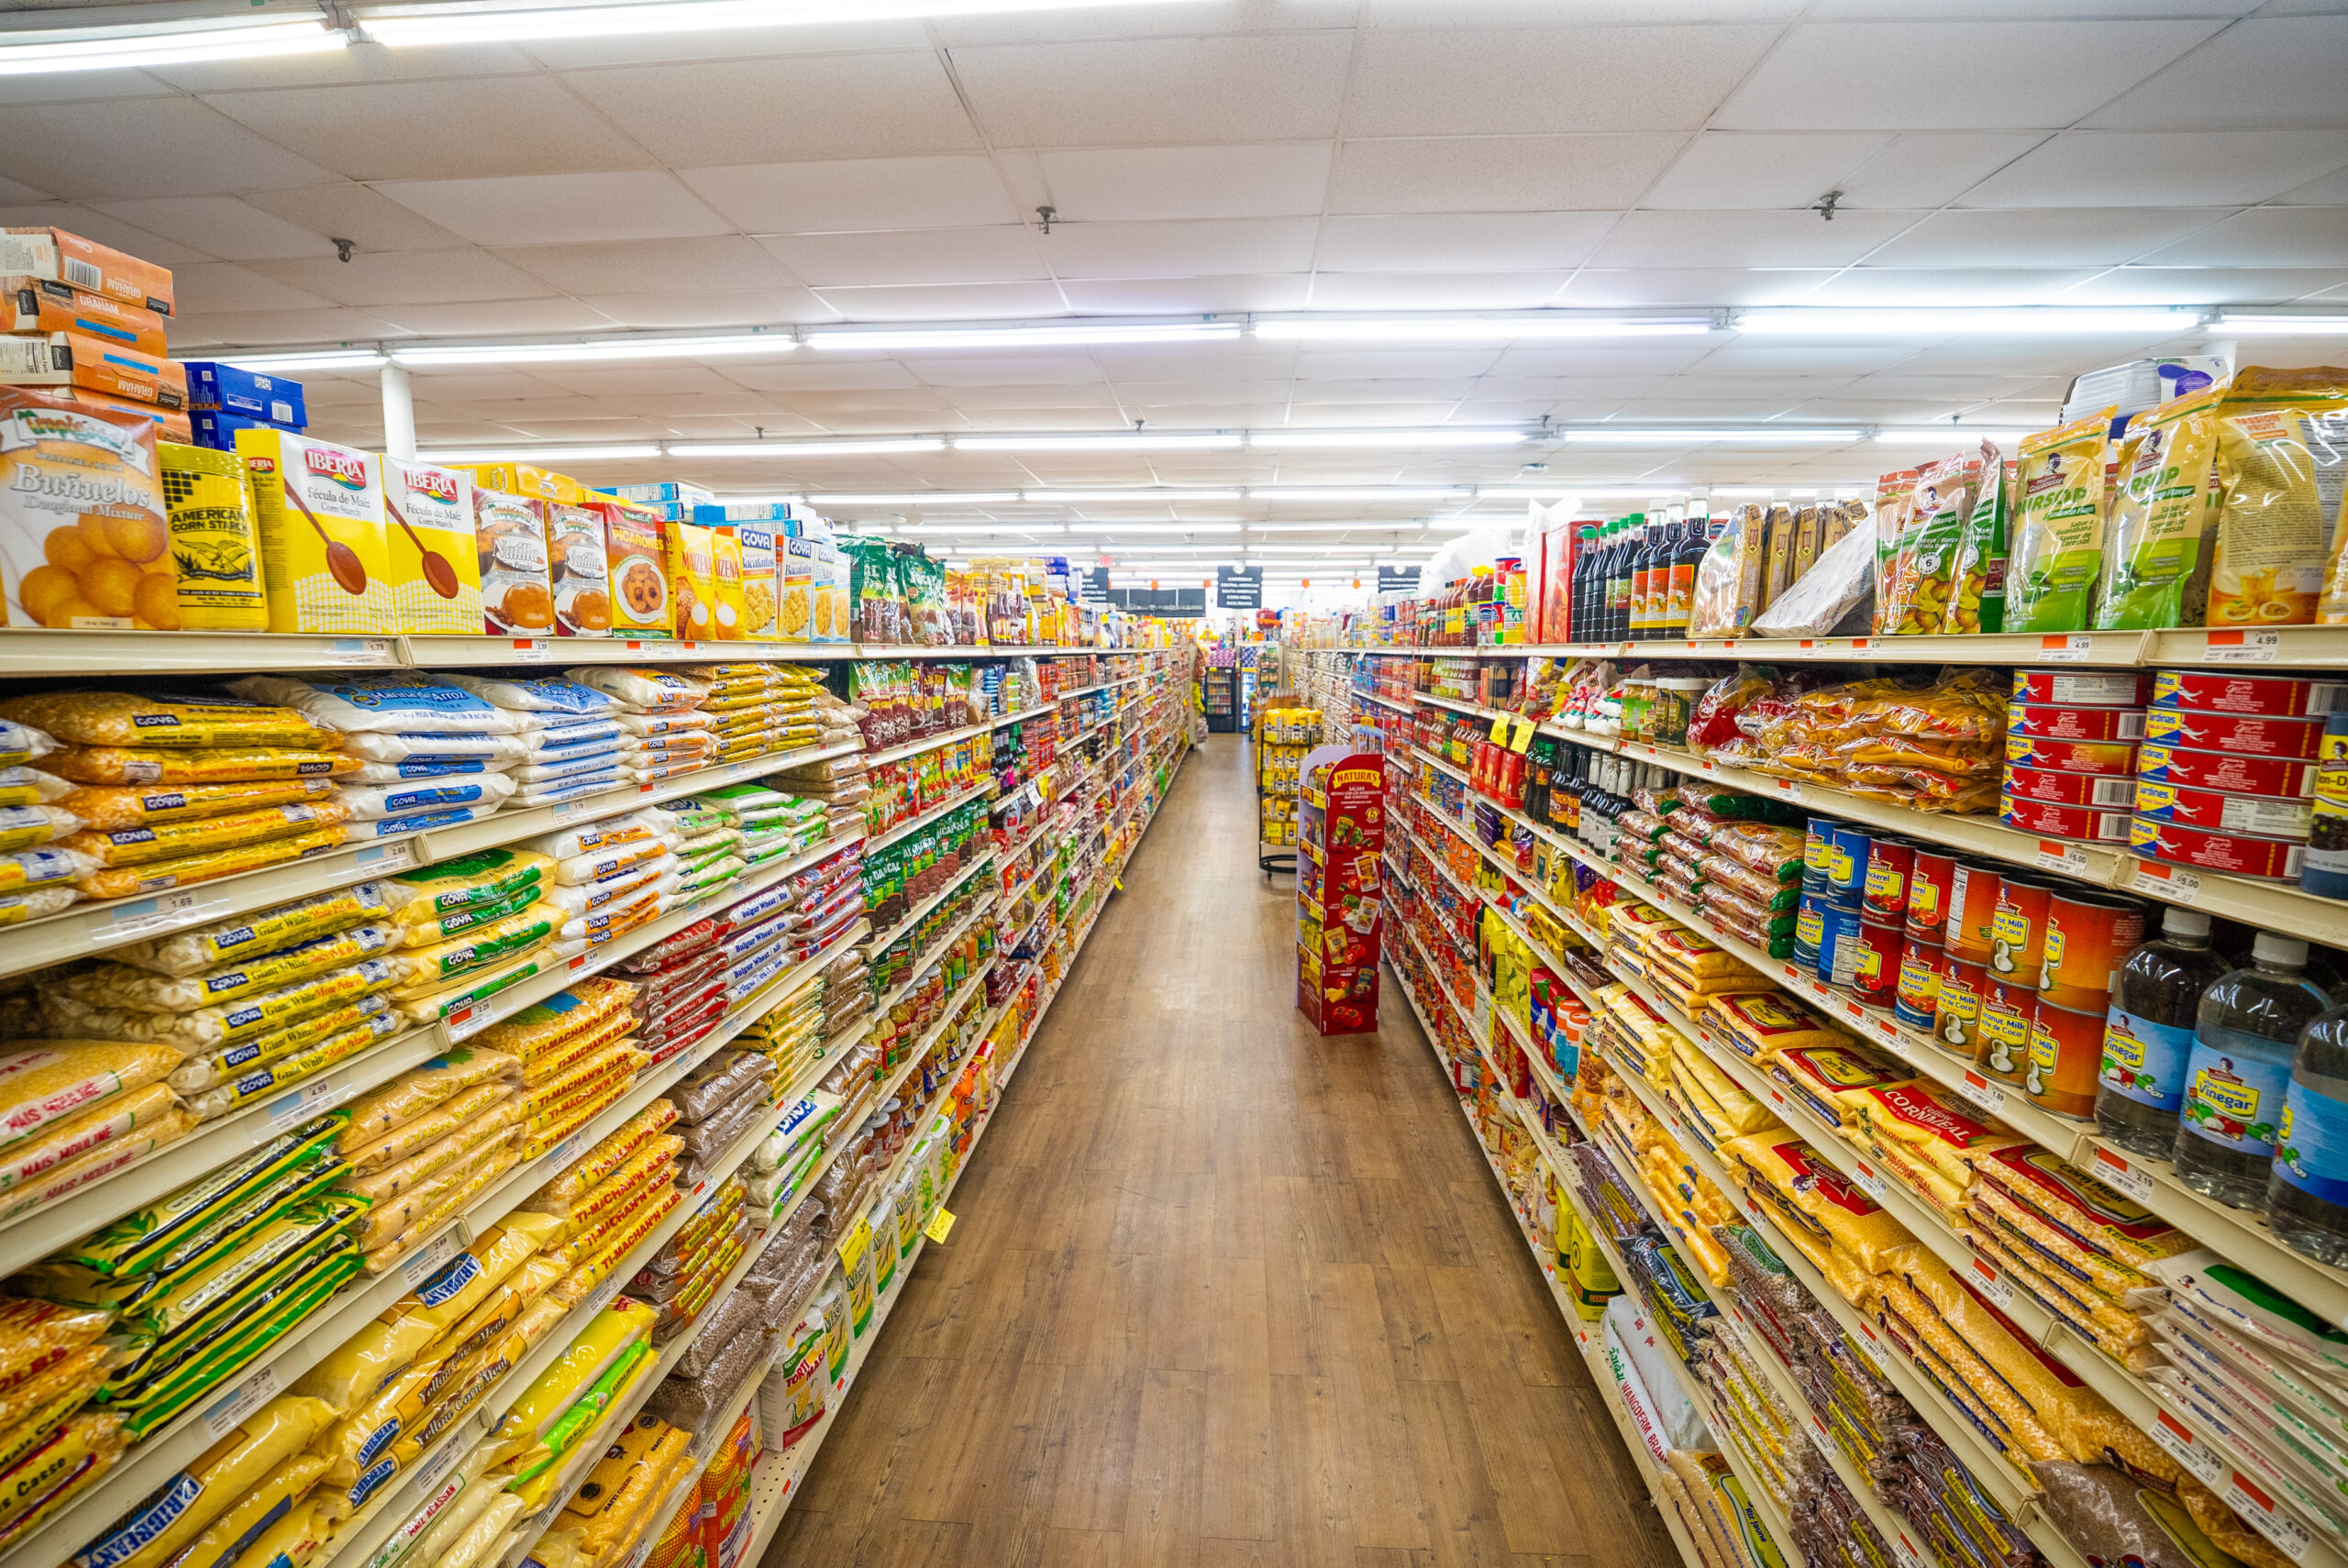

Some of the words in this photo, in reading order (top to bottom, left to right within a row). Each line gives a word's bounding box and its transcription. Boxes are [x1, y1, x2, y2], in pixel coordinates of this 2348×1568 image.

[107, 278, 140, 299] GRAHAM
[79, 295, 119, 315] GRAHAM
[118, 380, 153, 397] GRAHAM
[307, 451, 363, 479] IBERIA
[11, 462, 150, 508] Buñuelos
[406, 473, 456, 497] IBERIA
[307, 487, 338, 502] Fécula
[95, 505, 145, 521] Mixture
[171, 509, 246, 525] AMERICAN
[321, 502, 338, 512] Corn
[339, 506, 360, 517] Starch
[406, 503, 432, 517] Fécula
[434, 509, 443, 517] de
[172, 521, 205, 532] CORN
[209, 520, 248, 532] STARCH
[418, 516, 433, 525] Corn
[435, 520, 454, 529] Starch
[613, 529, 663, 550] PICARONES
[743, 531, 770, 548] GOYA
[493, 539, 539, 561] Natilla
[791, 540, 811, 558] GOYA
[681, 551, 713, 574] MAIZENA
[742, 557, 774, 569] Bacalaitos
[785, 564, 812, 576] Bacalaitos
[2075, 641, 2089, 649] 4.99
[2256, 635, 2277, 645] 4.99
[432, 691, 466, 701] Arroz
[136, 715, 179, 726] GOYA
[2148, 712, 2176, 724] Sardinas
[405, 765, 428, 774] GOYA
[393, 795, 416, 806] GOYA
[2139, 787, 2168, 800] Sardines
[147, 796, 184, 809] GOYA
[384, 821, 407, 834] GOYA
[112, 831, 153, 845] GOYA
[391, 846, 406, 856] 2.69
[598, 860, 616, 874] GOYA
[171, 897, 193, 909] 1.69
[441, 894, 469, 906] GOYA
[592, 892, 611, 907] GOYA
[742, 906, 760, 918] Bulgur
[760, 897, 776, 910] Wheat
[444, 914, 473, 929] GOYA
[1799, 919, 1822, 930] Mackerel
[2008, 919, 2025, 929] Milk
[219, 929, 255, 945] GOYA
[735, 938, 755, 953] Bulgur
[755, 927, 773, 942] Wheat
[2004, 927, 2021, 936] Coco
[448, 950, 475, 966] GOYA
[734, 963, 753, 979] Bulgur
[753, 951, 770, 966] Wheat
[210, 975, 248, 989] GOYA
[1901, 968, 1930, 983] Mackerel
[229, 1010, 262, 1025] GOYA
[291, 993, 316, 1006] White
[1955, 1001, 1974, 1011] Coco
[1959, 996, 1977, 1005] Milk
[536, 1014, 601, 1055] TI-MACHAN'N
[602, 1001, 624, 1021] 2LBS
[2002, 1028, 2021, 1038] Coco
[2007, 1020, 2025, 1031] Milk
[226, 1045, 260, 1066] GOYA
[289, 1026, 313, 1043] White
[557, 1034, 612, 1069] TI-MACHAN'N
[612, 1019, 632, 1036] 2LBS
[2039, 1042, 2054, 1052] Milk
[2105, 1040, 2141, 1062] Vinegar
[2035, 1048, 2051, 1058] Coco
[1822, 1057, 1840, 1069] Corn
[238, 1076, 272, 1095] GOYA
[537, 1069, 604, 1107] TI-MACHAN'N
[604, 1052, 629, 1074] 2LBS
[311, 1084, 328, 1097] 4.59
[2198, 1081, 2253, 1110] Vinegar
[1884, 1090, 1970, 1142] CORNMEAL
[1922, 1103, 1954, 1121] Yellow
[1873, 1120, 1902, 1143] YELLOW
[20, 1153, 55, 1178] MAIS
[59, 1123, 112, 1161] MOULINÉ
[1876, 1138, 1898, 1162] YELLOW
[574, 1169, 645, 1224] TI-MACHAN'N
[645, 1151, 670, 1175] 4LBS
[2059, 1164, 2092, 1185] Corn
[2093, 1181, 2128, 1203] Meal
[2136, 1173, 2153, 1187] 2.19
[601, 1210, 661, 1270] TI-MACHAN'N
[661, 1193, 681, 1214] 4LBS
[1999, 1219, 2012, 1231] Corn
[2104, 1225, 2160, 1255] KERNEL
[418, 1367, 453, 1405] Yellow
[479, 1314, 506, 1345] Meal
[785, 1358, 811, 1388] TORTI
[414, 1408, 454, 1449] Yellow
[454, 1385, 482, 1412] Corn
[482, 1355, 509, 1387] Meal
[1621, 1381, 1653, 1435] WANGDERM
[1916, 1360, 1931, 1376] Corn
[1931, 1375, 1945, 1395] Meal
[1948, 1391, 1976, 1423] Semoule
[1976, 1422, 1986, 1433] de
[1985, 1431, 2002, 1452] Mais
[36, 1400, 79, 1436] Casse
[358, 1418, 401, 1467] CARIBBEAN
[2202, 1450, 2222, 1470] 3.99
[17, 1456, 67, 1497] Casse
[426, 1484, 457, 1519] ACASSAN
[604, 1493, 619, 1512] HAITI
[1954, 1482, 1966, 1500] Kidney
[1991, 1529, 2005, 1549] Rouge
[1744, 1507, 1755, 1520] Riz
[1750, 1517, 1767, 1542] Jaune
